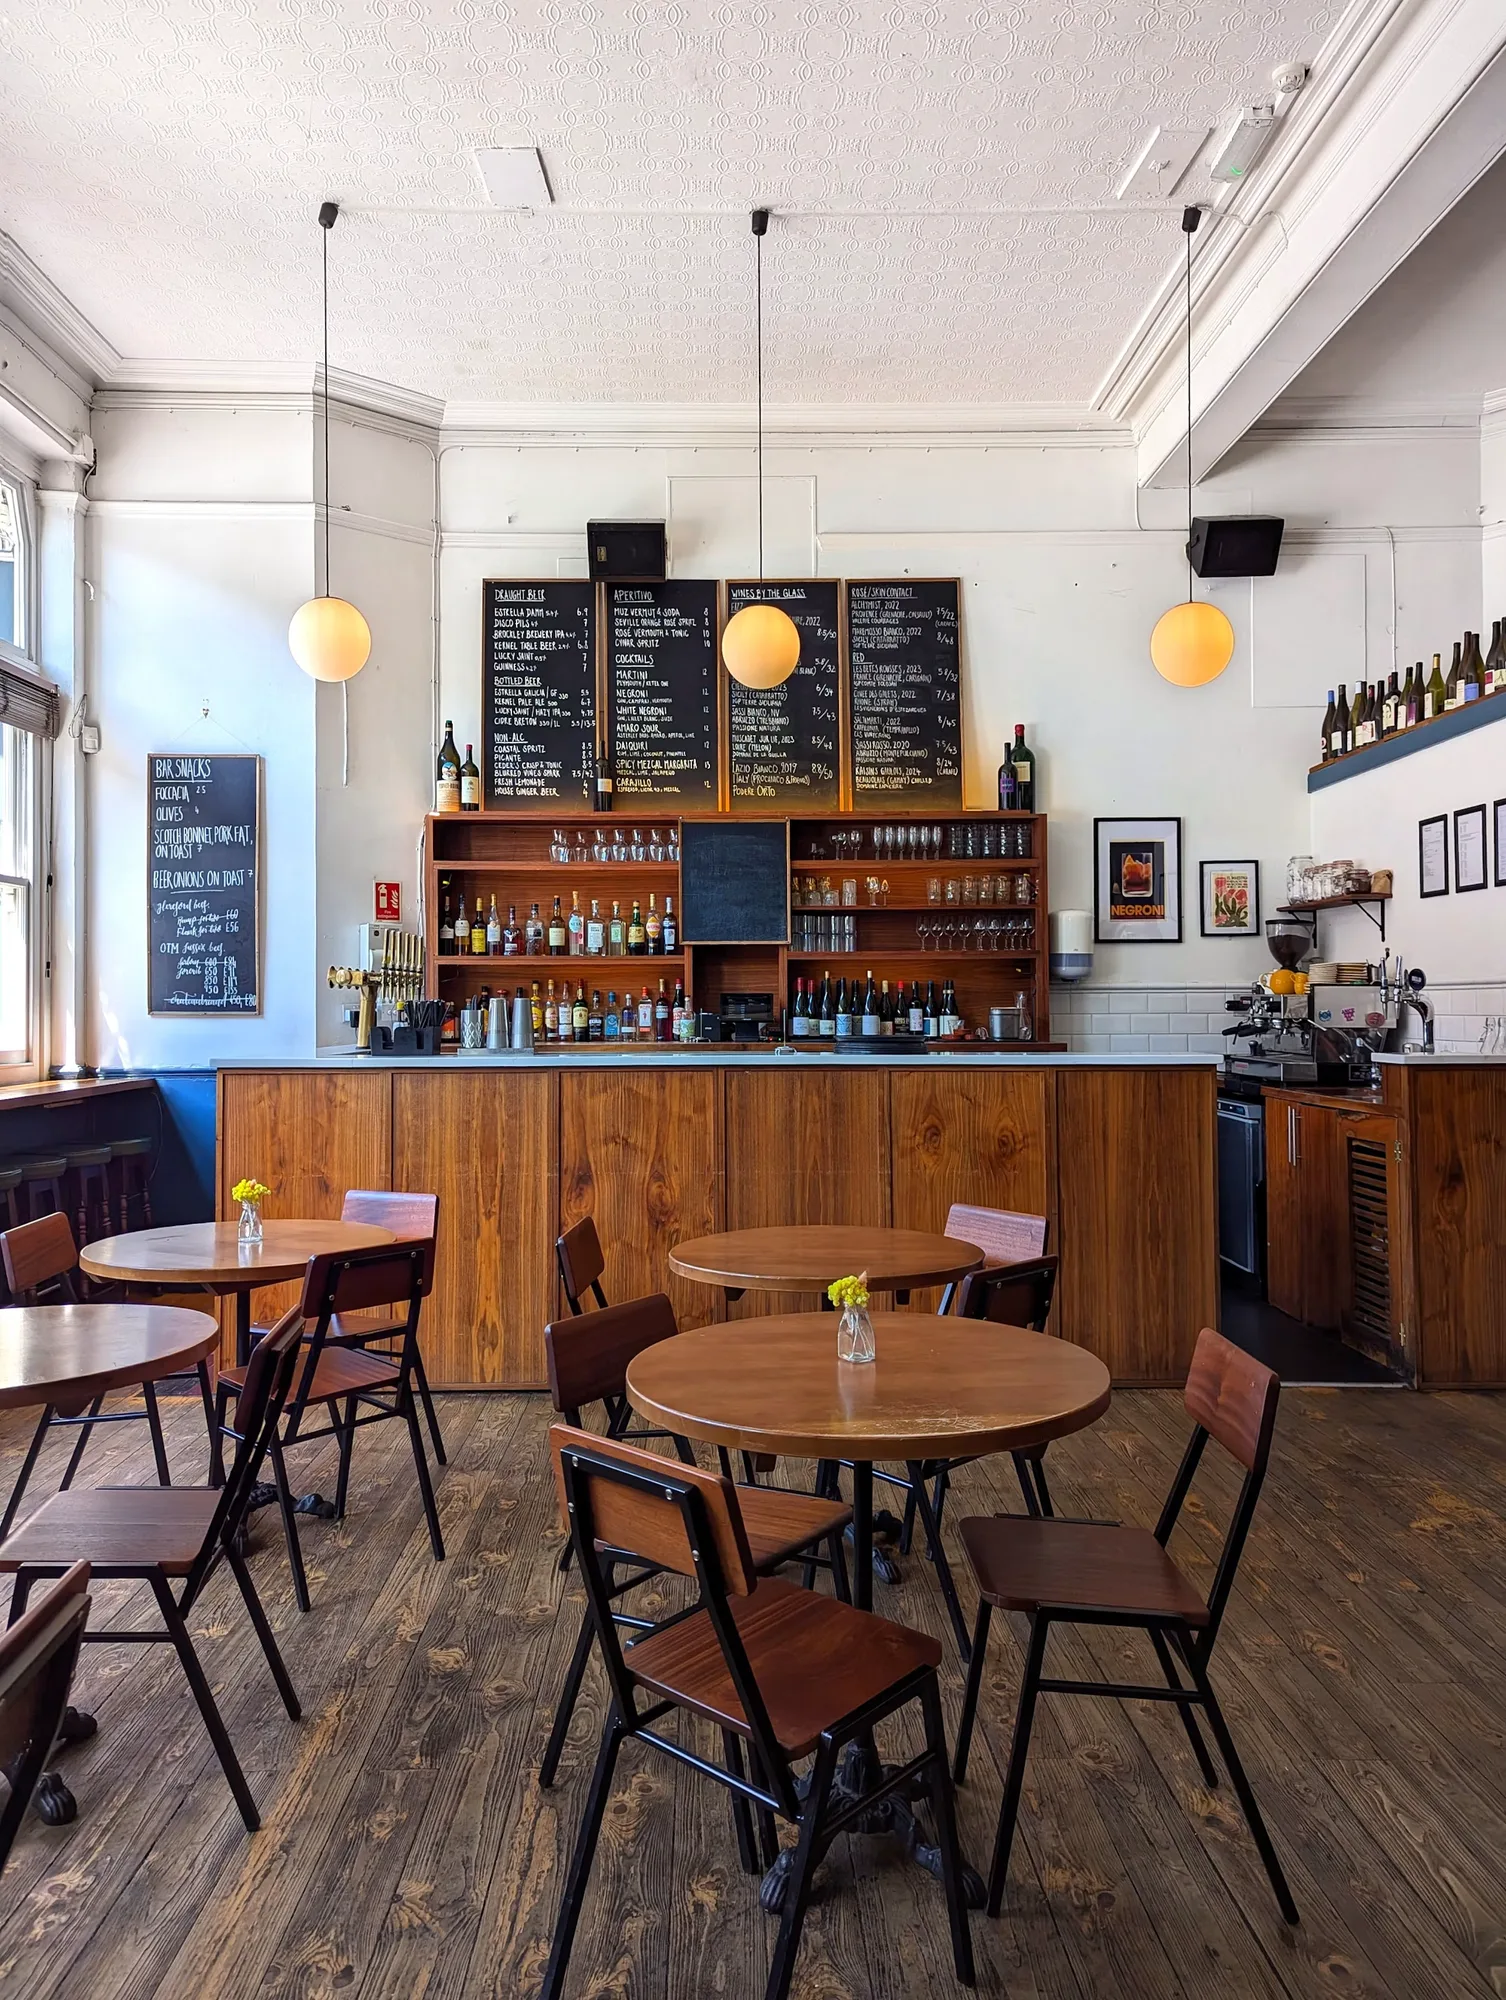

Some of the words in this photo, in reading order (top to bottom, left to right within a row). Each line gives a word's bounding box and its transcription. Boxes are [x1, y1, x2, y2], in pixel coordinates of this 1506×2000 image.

[494, 589, 525, 600] DRAUGHT
[527, 589, 546, 600] BEER
[614, 590, 652, 600] APERITIVO
[731, 589, 754, 598] WINES
[757, 589, 765, 598] BY
[767, 589, 780, 597] THE
[783, 589, 806, 598] GLASS
[887, 588, 912, 597] CONTACT
[885, 601, 899, 610] 2022
[494, 608, 524, 616] ESTRELLA
[577, 608, 588, 616] 6.9
[614, 608, 628, 616] MUZ
[630, 608, 655, 618] VERMUT
[662, 608, 680, 616] SODA
[494, 619, 513, 627] DISCO
[516, 619, 529, 627] PILS
[614, 618, 640, 626] SEVILLE
[492, 630, 524, 639] BROCKLEY
[555, 630, 565, 638] IPA
[615, 627, 631, 637] ROSÉ
[634, 629, 664, 637] VERMOUTH
[671, 629, 689, 637] TONIC
[703, 629, 709, 637] 10
[907, 627, 921, 636] 2022
[494, 642, 517, 650] KERNEL
[521, 642, 538, 650] TABLE
[540, 641, 557, 650] BEER
[637, 639, 659, 648] SPRITZ
[494, 652, 515, 660] LUCKY
[517, 652, 534, 660] SAINT
[615, 654, 653, 665] COCKTAILS
[853, 652, 865, 662] RED
[494, 662, 525, 670] GUINNESS
[907, 665, 922, 673] 2023
[616, 670, 648, 680] MARTINI
[494, 676, 523, 685] BOTTLED
[525, 676, 542, 685] BEER
[494, 688, 521, 696] ESTRELLA
[616, 689, 648, 698] NEGRONI
[901, 690, 916, 698] 2022
[936, 690, 955, 701] 7/38
[518, 698, 532, 706] PALE
[495, 707, 512, 716] LUCKY
[553, 708, 561, 717] IPA
[616, 706, 636, 715] WHITE
[639, 707, 667, 715] NEGRONI
[514, 718, 537, 726] BRETON
[616, 723, 639, 732] AMARO
[641, 724, 661, 734] SOUR
[494, 745, 520, 753] COASTAL
[523, 745, 546, 753] SPRITZ
[616, 741, 648, 750] DAIQUIRI
[749, 744, 771, 753] (MELON)
[855, 741, 871, 749] SASSI
[893, 741, 910, 749] 2020
[615, 759, 635, 769] SPICY
[637, 760, 662, 769] MEZCAL
[664, 759, 697, 770] MARGARITA
[156, 759, 174, 779] BAR
[175, 758, 210, 783] SNACKS
[495, 778, 512, 786] FRESH
[616, 778, 651, 787] CARAJILLO
[155, 785, 189, 802] FOCCACIA
[495, 787, 514, 796] HOUSE
[541, 788, 560, 796] BEER
[757, 785, 775, 796] ORTO
[156, 806, 183, 822] OLIVES
[154, 828, 181, 844] SCOTCH
[184, 827, 213, 845] BONNET,
[215, 825, 233, 845] PORK
[234, 825, 253, 846] FAT,
[155, 845, 168, 858] ON
[169, 844, 193, 860] TOAST
[153, 870, 173, 889] BEER
[173, 870, 204, 888] ONIONS
[207, 870, 219, 886] ON
[222, 869, 244, 888] TOAST
[1111, 905, 1164, 916] NEGRONI
[226, 921, 239, 932] £56
[160, 943, 179, 954] OTM
[205, 967, 217, 975] 650
[204, 976, 218, 985] 850
[204, 986, 218, 994] 950
